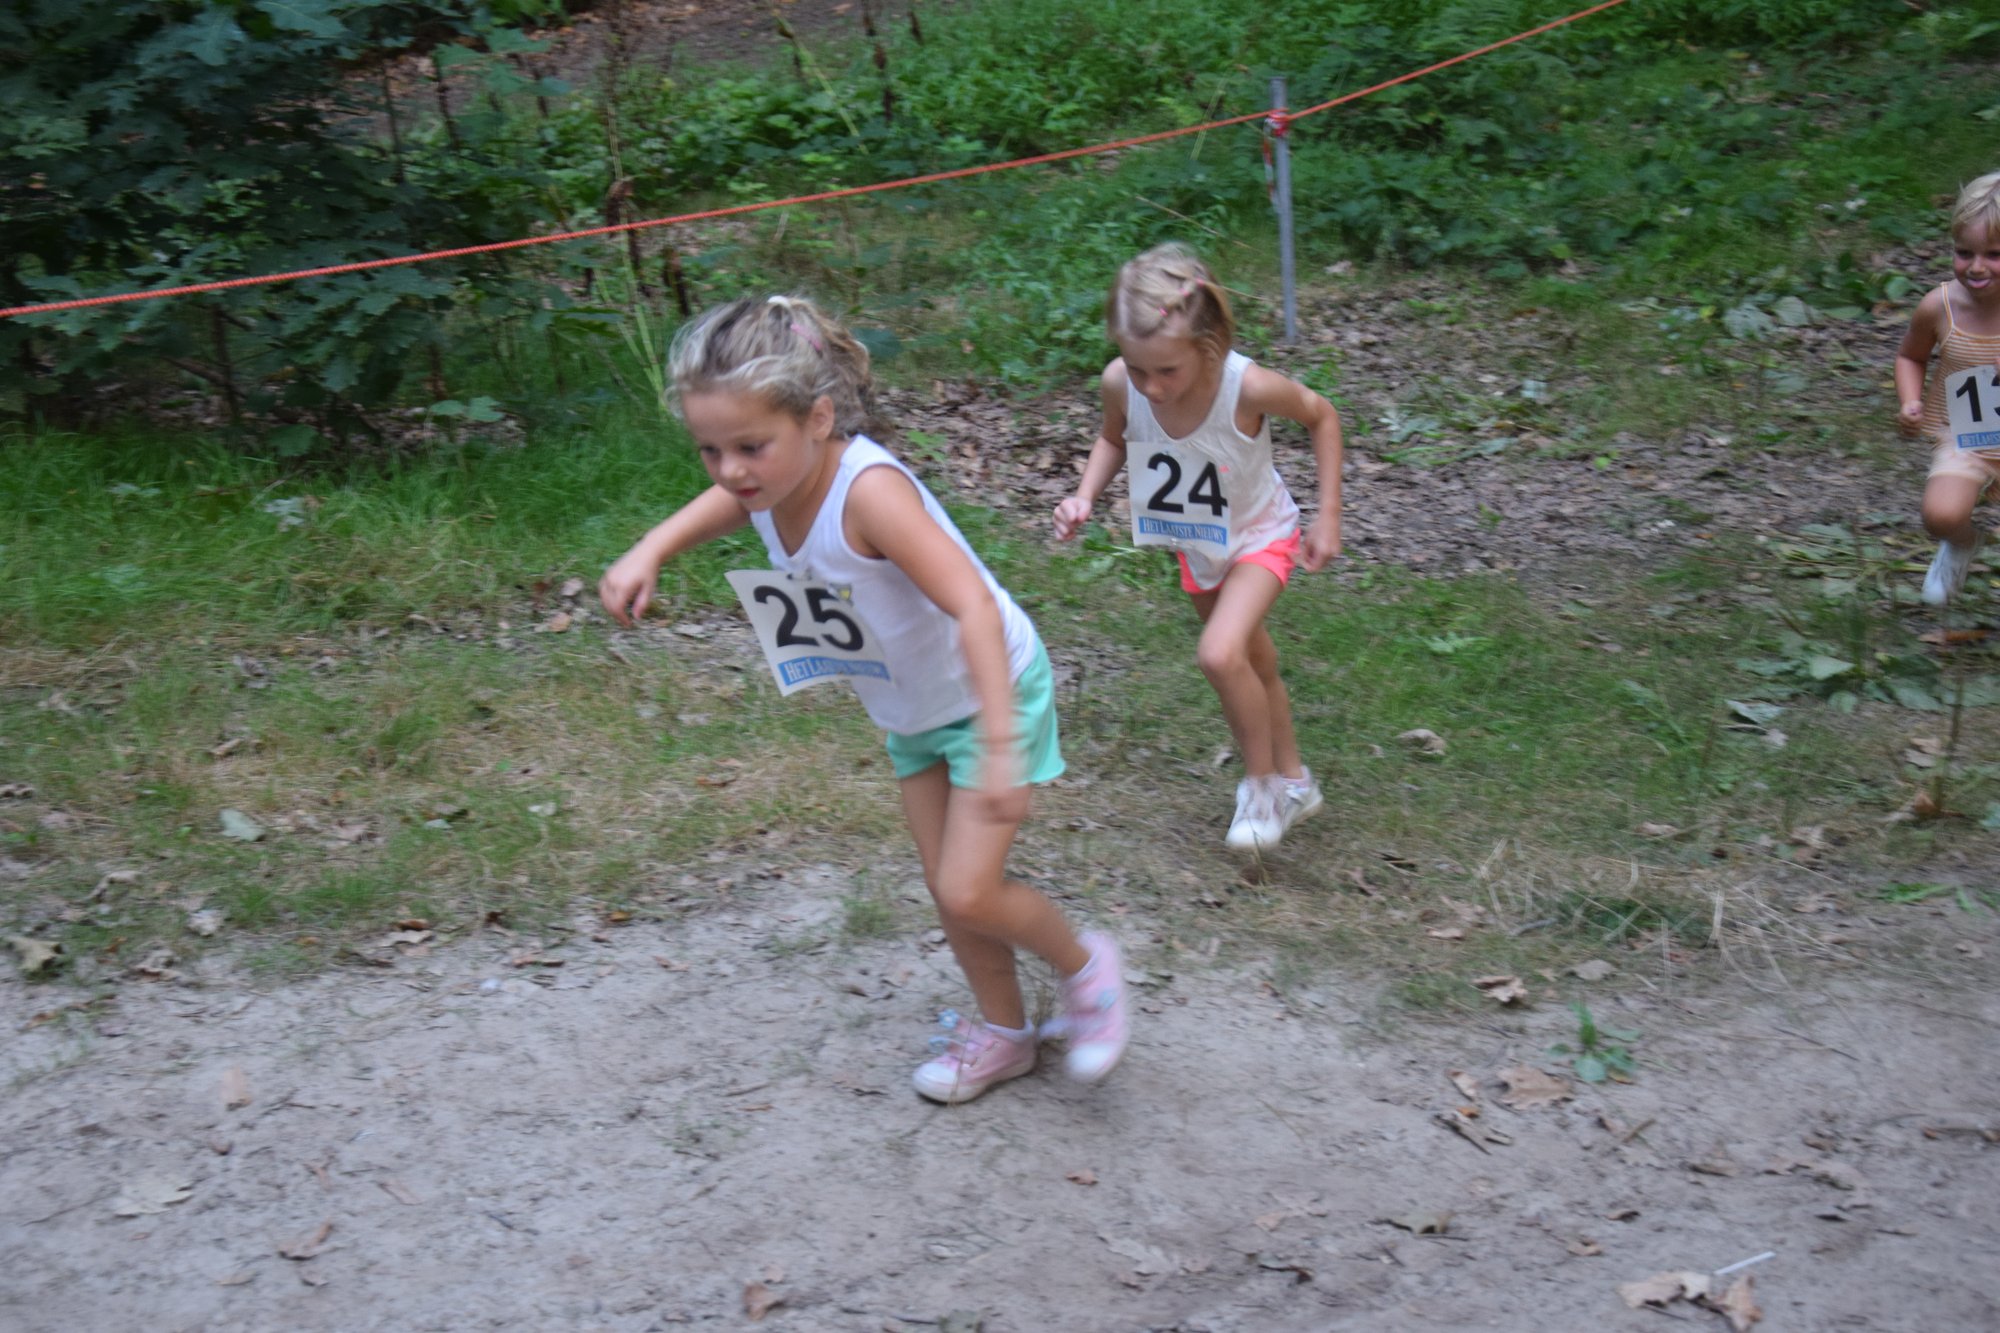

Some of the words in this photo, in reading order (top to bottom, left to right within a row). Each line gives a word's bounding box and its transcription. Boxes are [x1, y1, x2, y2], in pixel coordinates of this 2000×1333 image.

[1147, 452, 1228, 517] 24
[1143, 519, 1160, 533] HET
[753, 585, 864, 652] 25
[784, 660, 810, 682] HET
